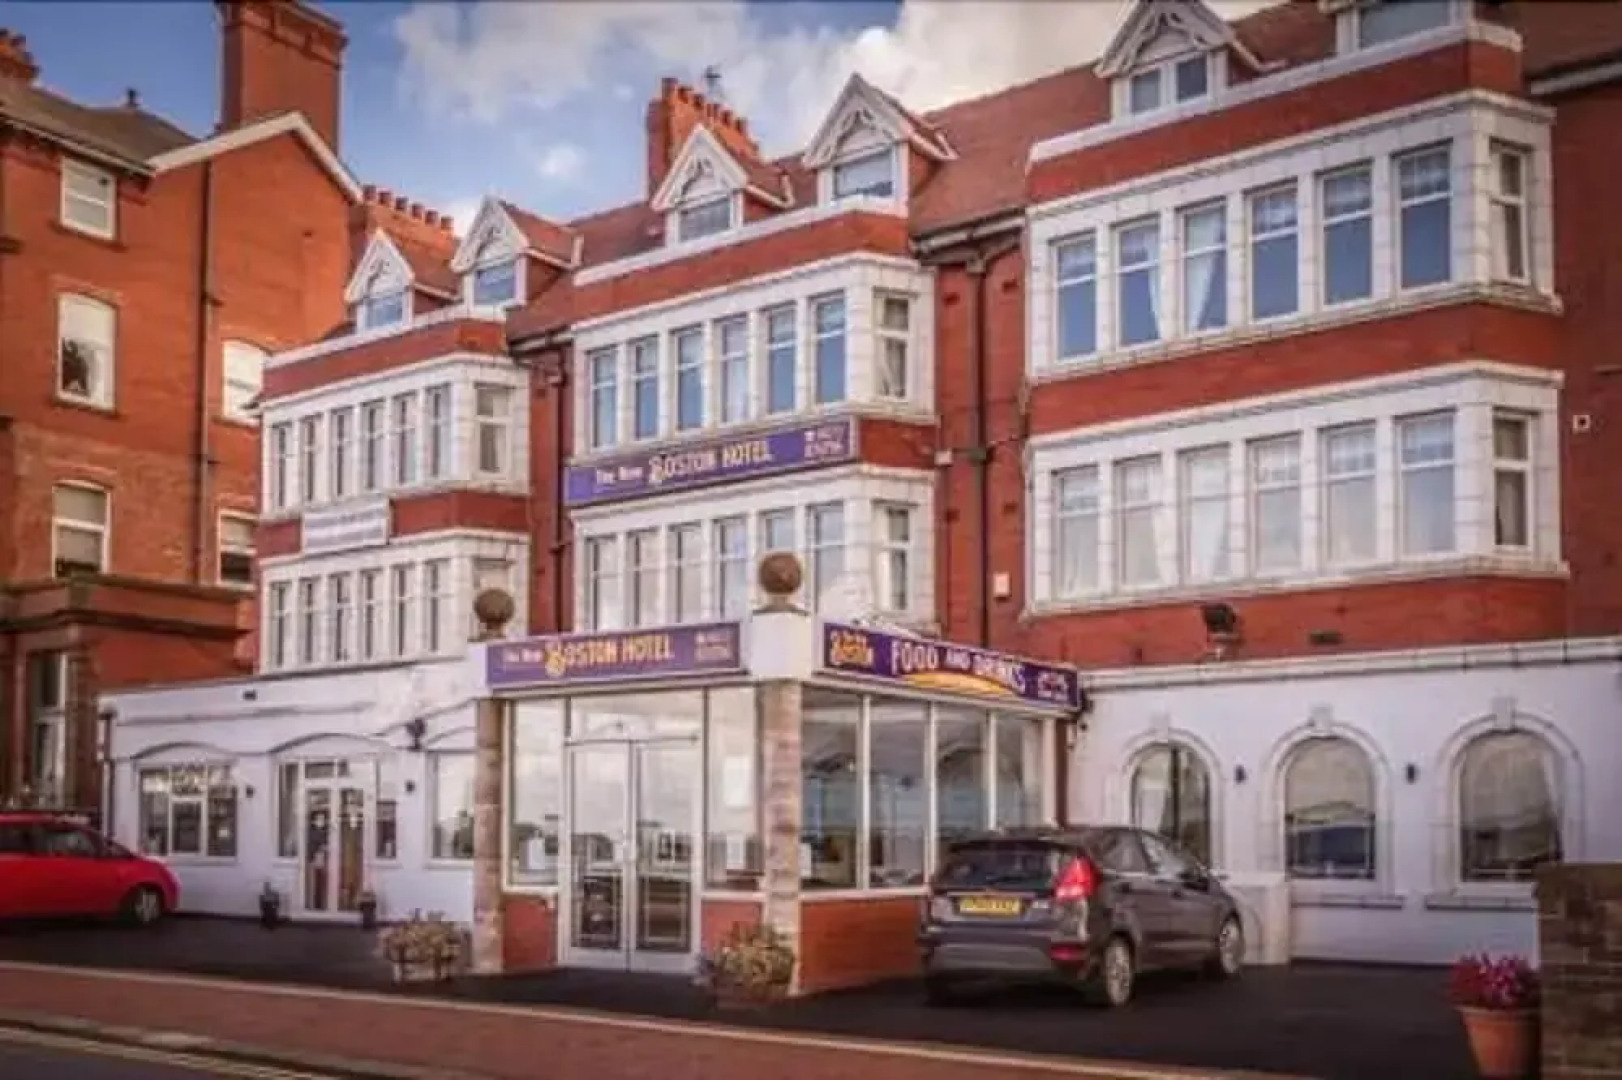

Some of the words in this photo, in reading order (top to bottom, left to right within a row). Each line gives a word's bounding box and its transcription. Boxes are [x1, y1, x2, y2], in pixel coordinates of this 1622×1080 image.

[722, 440, 772, 467] HOTEL
[622, 633, 675, 662] HOTEL
[891, 640, 939, 675] FOOD
